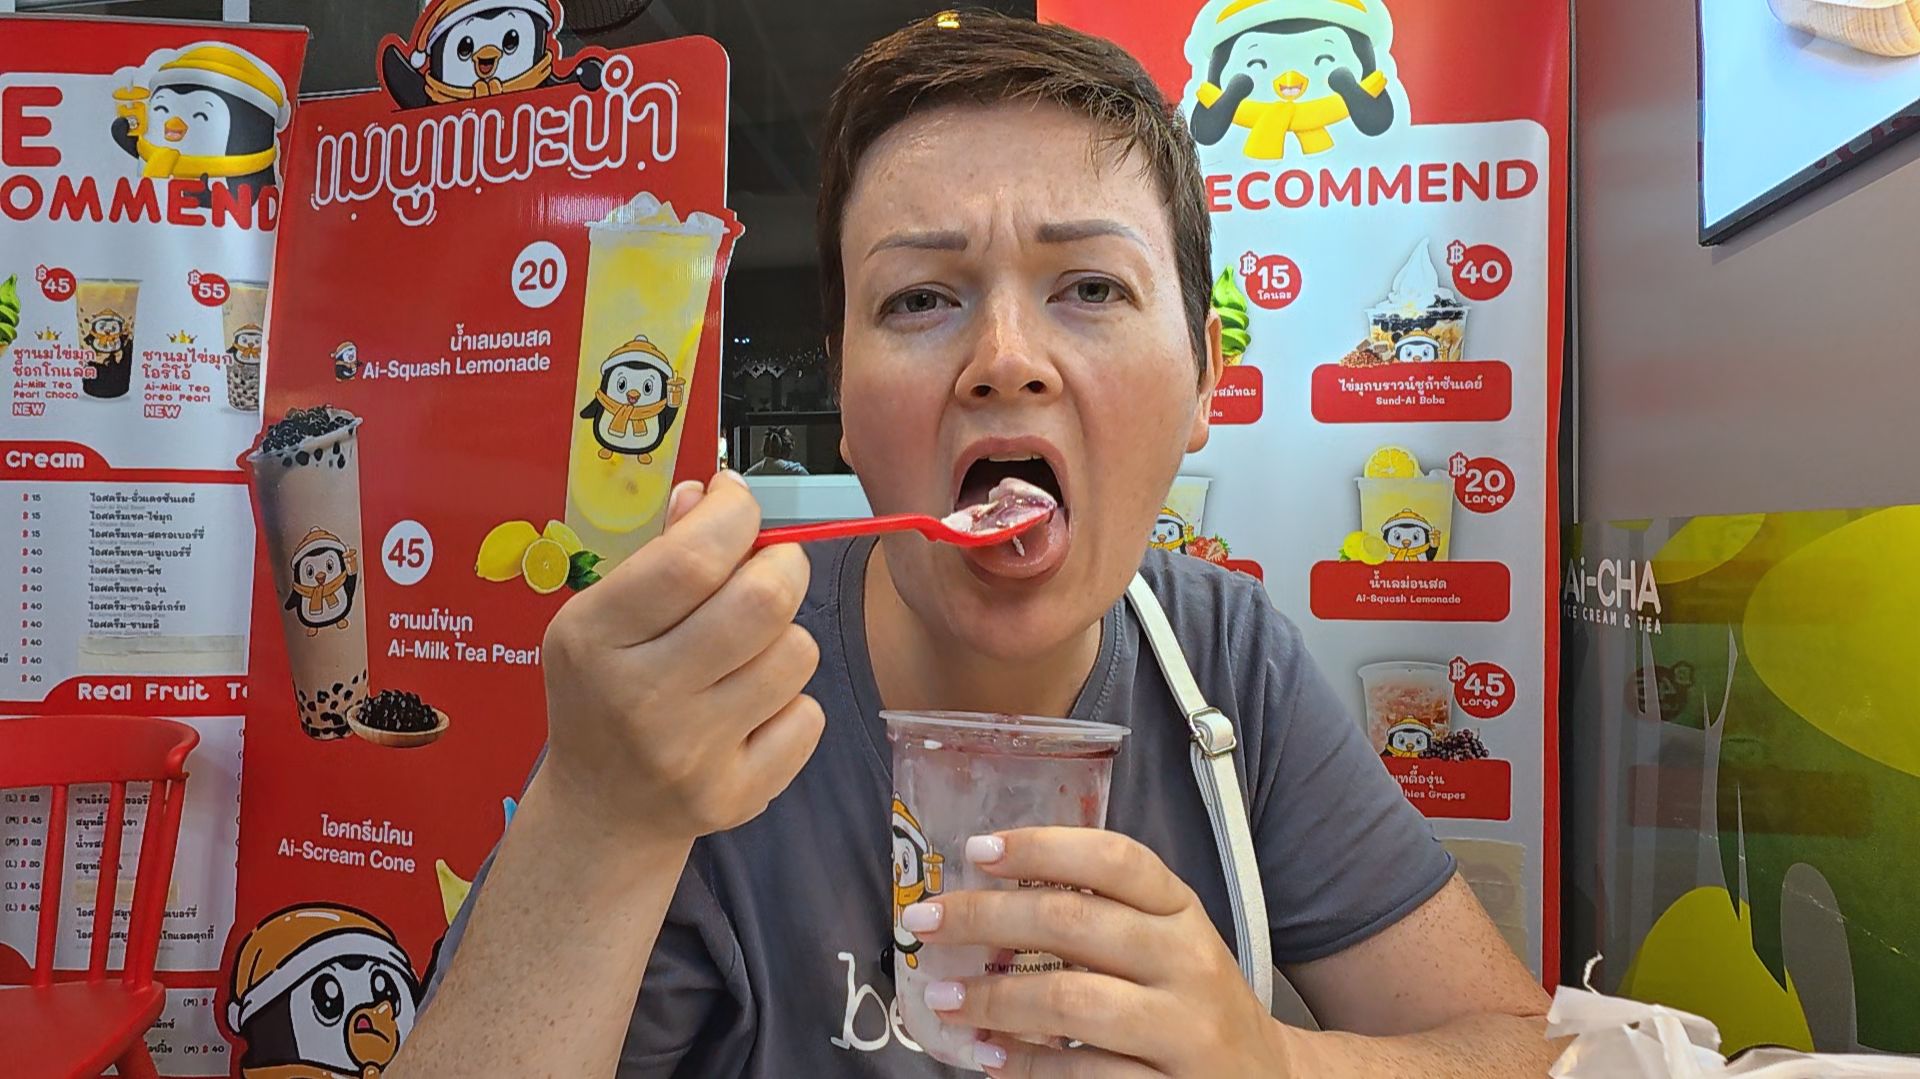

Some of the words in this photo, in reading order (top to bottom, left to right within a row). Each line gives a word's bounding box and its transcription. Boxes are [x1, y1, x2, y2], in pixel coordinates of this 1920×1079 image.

[2, 86, 63, 166] E
[315, 55, 679, 227] เมนูแนะนำ
[1205, 160, 1539, 213] ECOMMEND
[519, 258, 558, 291] 20
[450, 323, 551, 351] น้ำเลมอนสด
[142, 348, 233, 370] ชานมไข่มุก
[362, 358, 450, 381] Ai-Squash
[456, 353, 550, 375] Lemonade
[52, 381, 72, 389] Tea
[144, 382, 181, 391] Ai-Milk
[188, 384, 210, 392] Tea
[45, 391, 79, 399] Choco
[144, 393, 173, 401] Oreo
[179, 394, 211, 402] Pearl
[1419, 395, 1446, 405] Boba
[13, 403, 45, 415] NEW
[144, 404, 181, 418] NEW
[6, 450, 84, 468] Cream
[1464, 494, 1505, 506] Large
[388, 538, 424, 568] 45
[1564, 557, 1662, 614] Ai-CHA
[1355, 594, 1407, 605] Ai-Squash
[1410, 594, 1461, 604] Lemonade
[389, 608, 473, 638] ชานมไข่มุก
[1582, 608, 1617, 626] CREAM
[1623, 613, 1631, 629] &
[1637, 615, 1662, 635] TEA
[388, 639, 450, 661] Ai-Milk
[455, 642, 487, 662] Tea
[492, 644, 540, 665] Pearl
[30, 675, 42, 683] 40
[77, 683, 131, 700] Real
[145, 679, 209, 700] Fruit
[1462, 697, 1499, 709] Large
[1428, 790, 1466, 800] Grapes
[321, 814, 413, 846] ไอศกรีมโคน
[278, 839, 365, 867] Ai-Scream
[370, 850, 416, 873] Cone
[183, 998, 198, 1008] (M)
[184, 1045, 199, 1054] (M)
